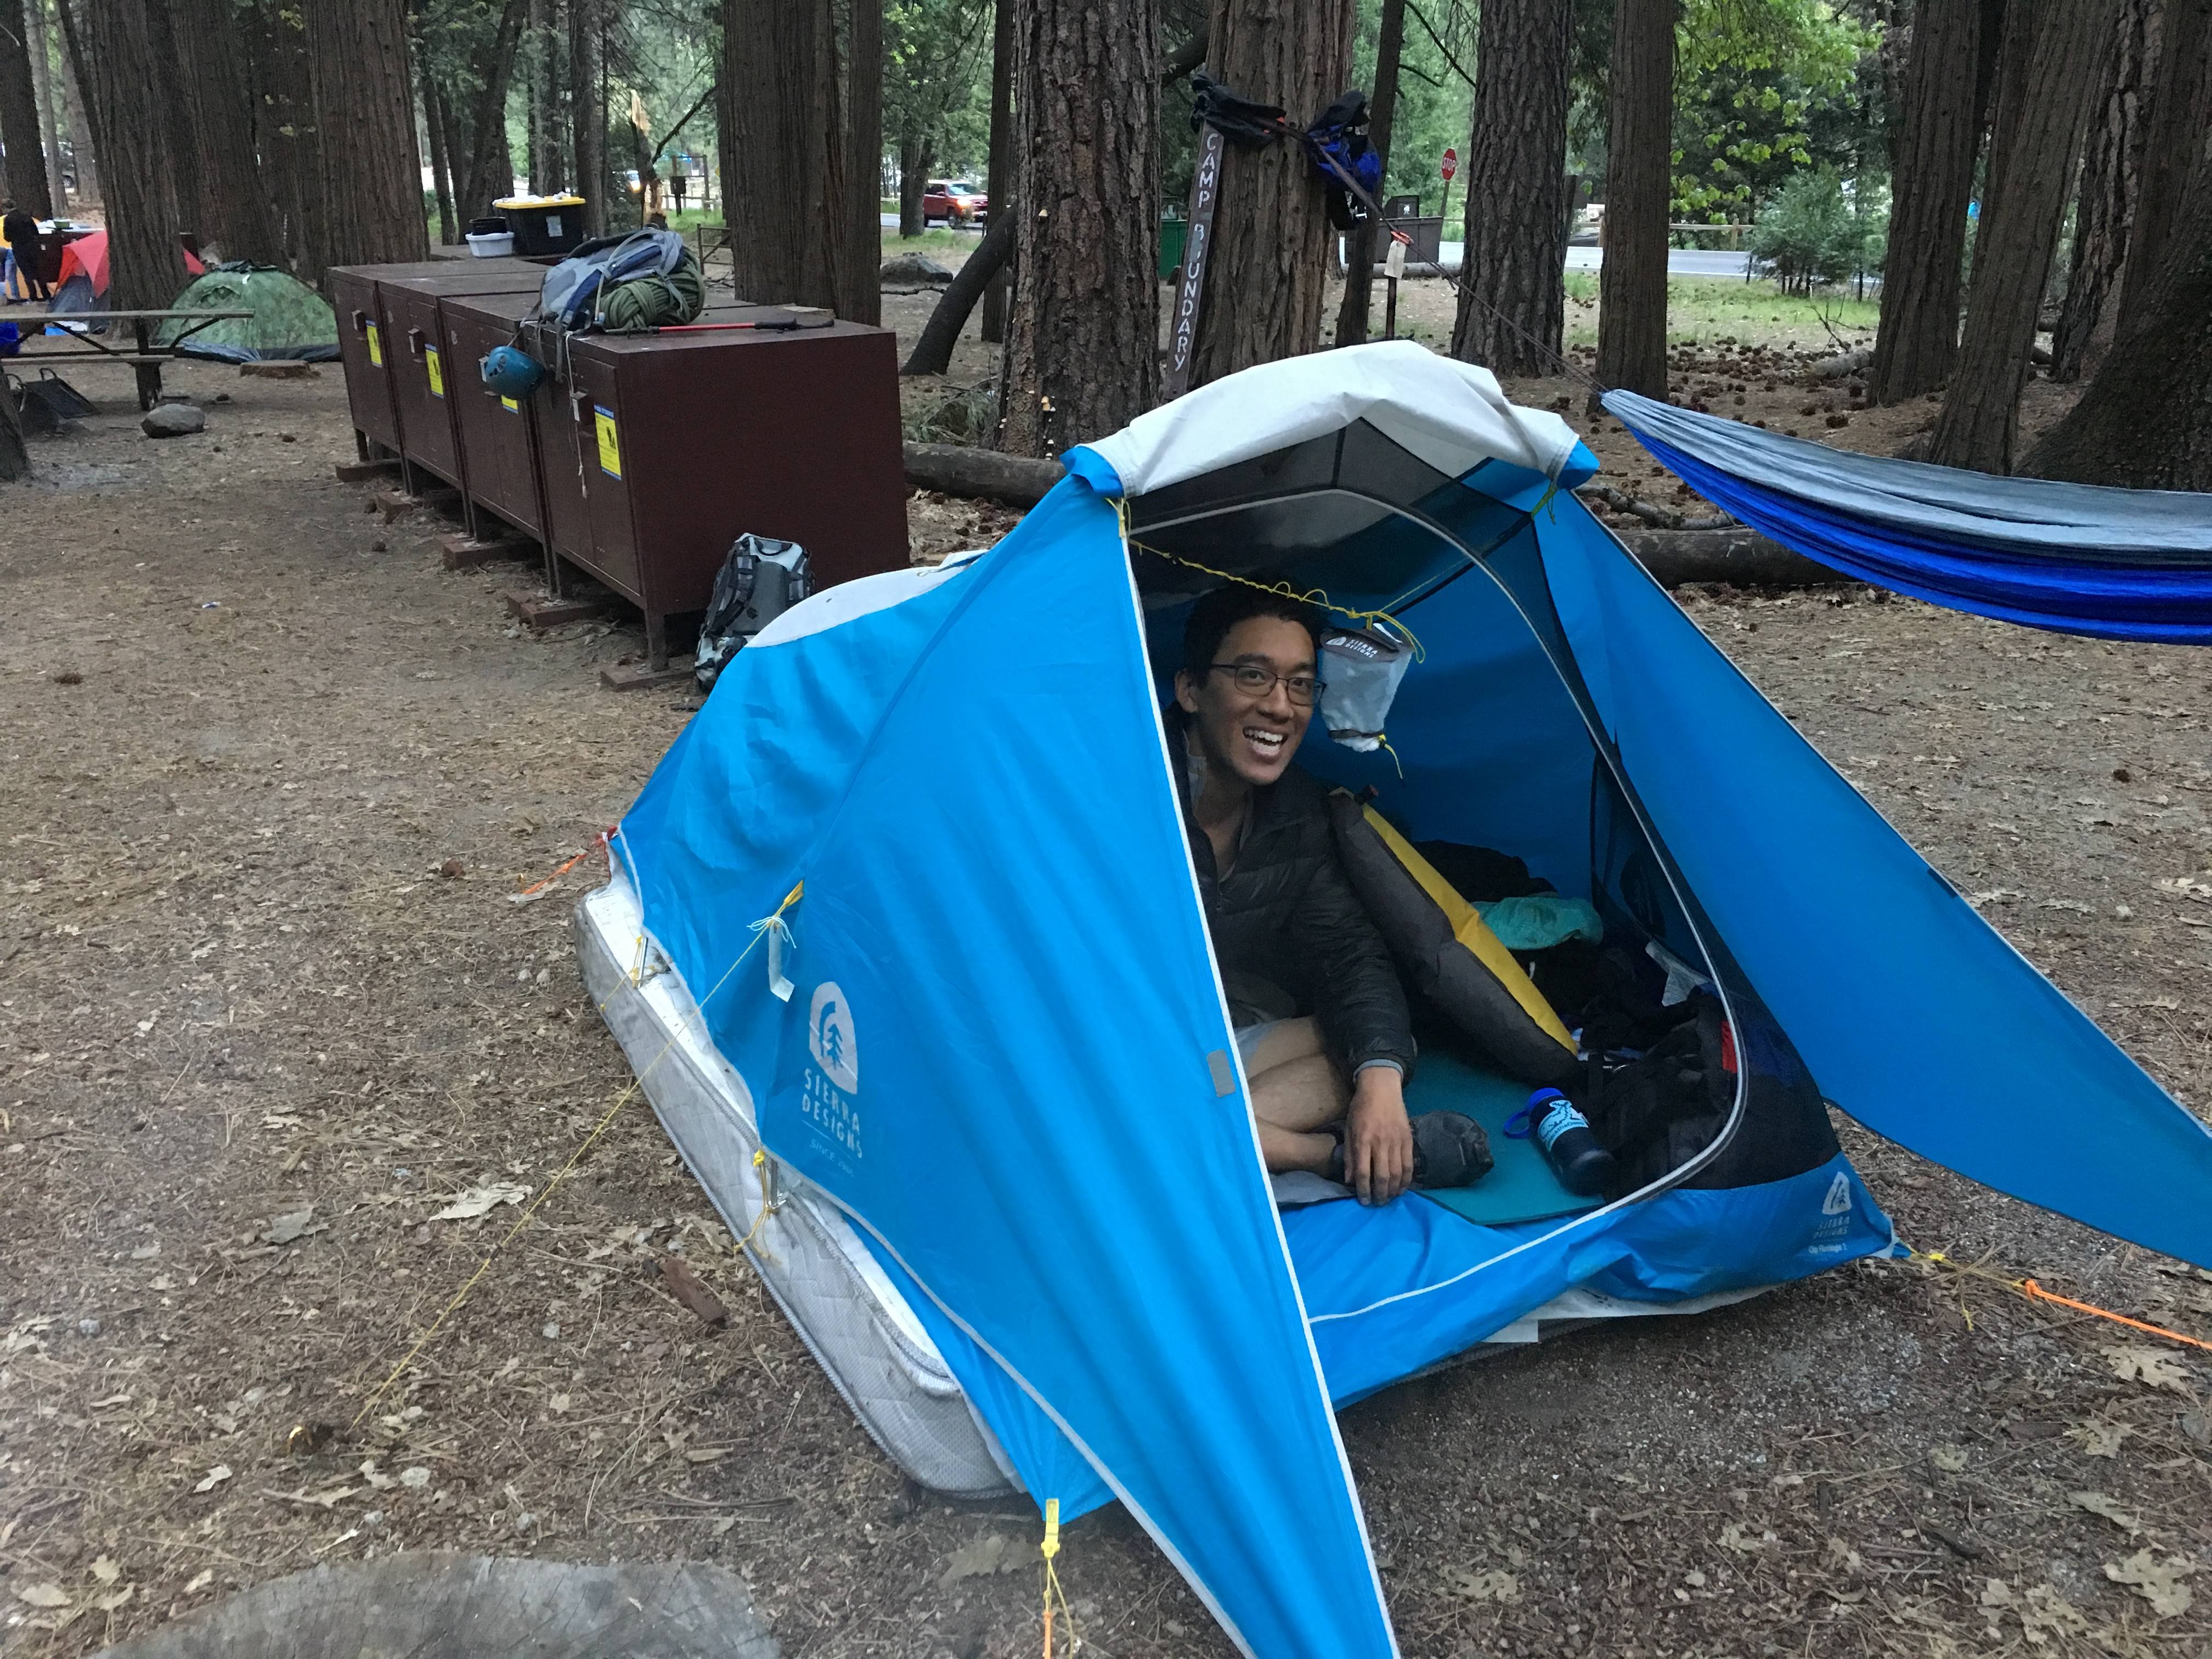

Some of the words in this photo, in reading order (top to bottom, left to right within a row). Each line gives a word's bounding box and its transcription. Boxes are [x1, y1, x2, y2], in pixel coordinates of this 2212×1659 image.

[1198, 133, 1218, 208] CAMP
[1442, 157, 1455, 172] STOP
[1173, 223, 1205, 372] BUNDARY
[1345, 643, 1374, 658] DESIGNS
[1349, 639, 1378, 654] SIERRA
[804, 1068, 860, 1136] SIERRA
[802, 1093, 863, 1159] DESIGNS
[810, 1138, 834, 1161] SINCE
[1817, 1216, 1849, 1231] SIERRA
